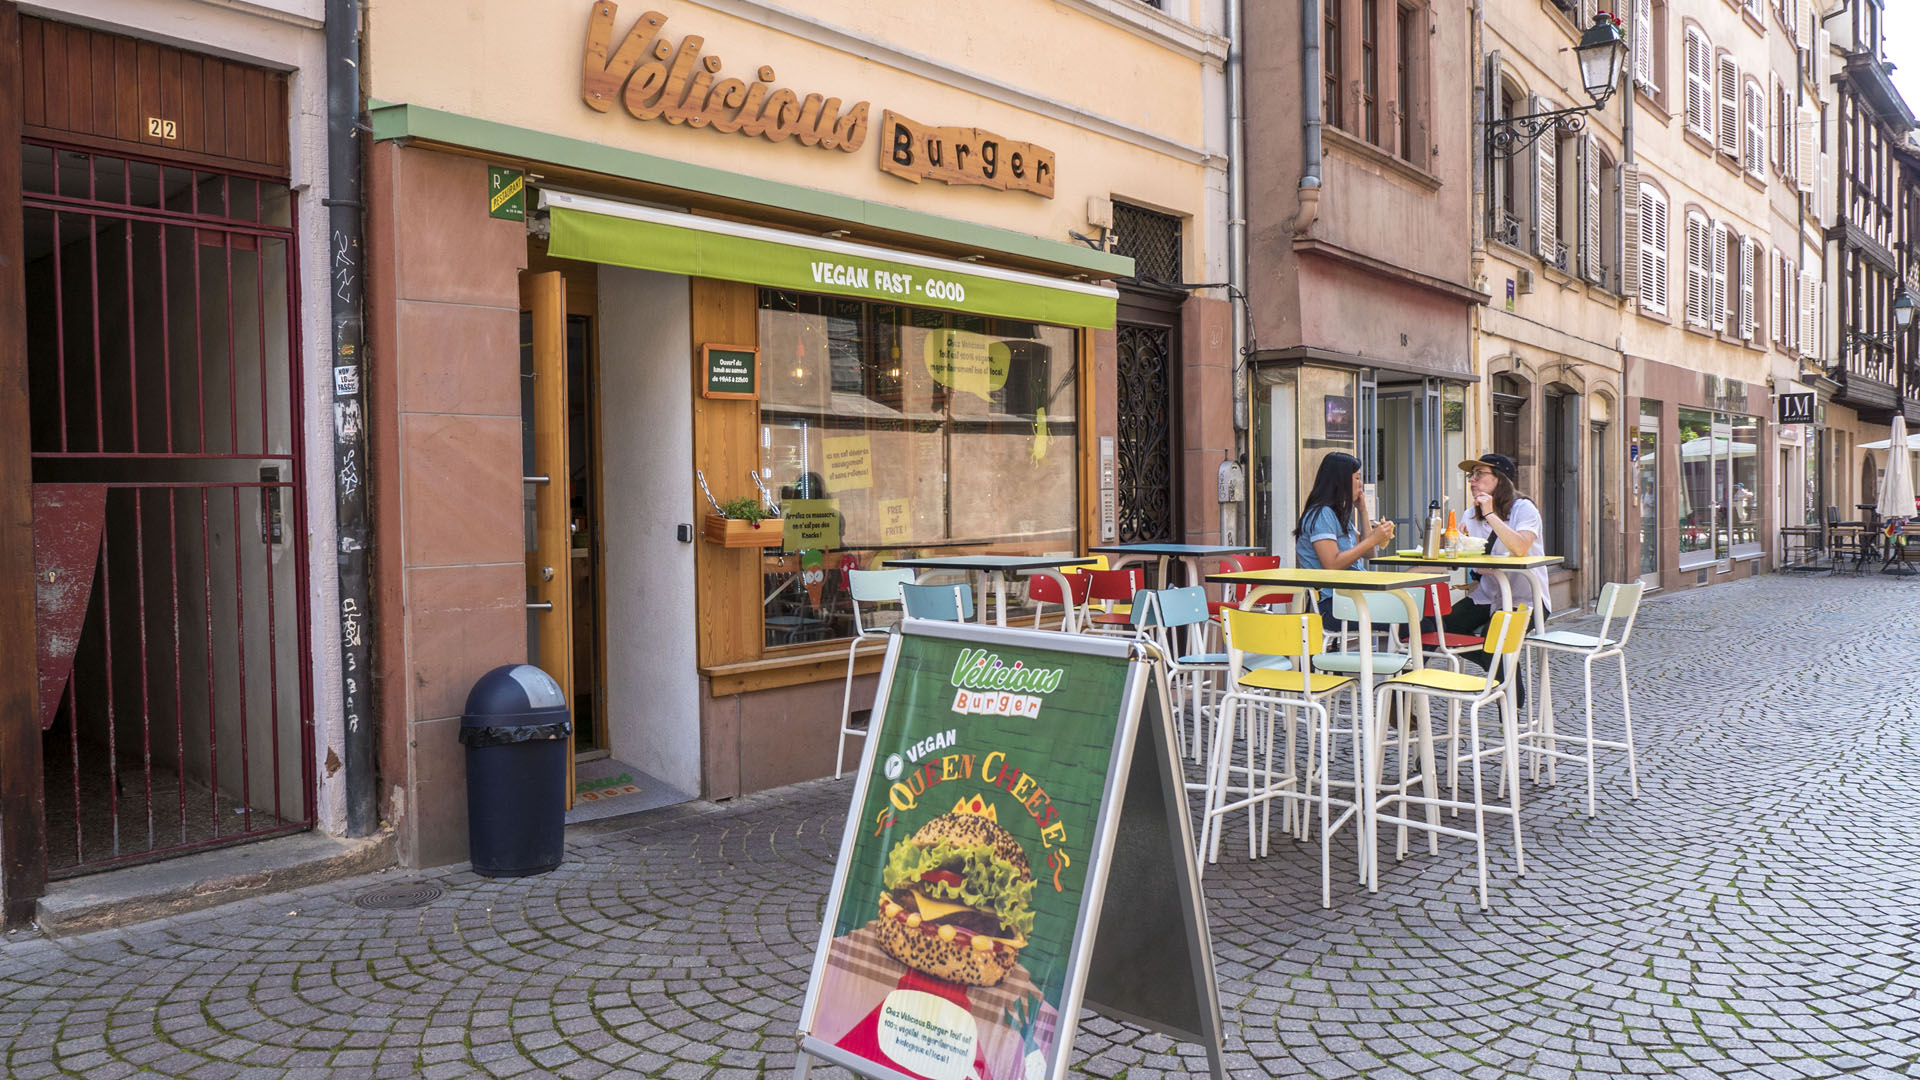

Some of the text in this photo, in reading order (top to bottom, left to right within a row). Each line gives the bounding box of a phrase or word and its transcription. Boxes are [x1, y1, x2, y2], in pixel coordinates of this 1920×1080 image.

[150, 120, 174, 138] 22
[893, 122, 1050, 184] Burger
[493, 177, 522, 208] RESTAURANT
[494, 174, 500, 189] R
[811, 262, 869, 288] VEGAN
[874, 270, 912, 294] FAST
[925, 278, 965, 302] GOOD
[1400, 332, 1408, 347] 18
[1784, 396, 1810, 416] LM
[888, 505, 903, 515] FREE
[886, 525, 903, 536] FRITE
[951, 648, 1064, 693] Vélicious
[956, 692, 1038, 712] Burger
[906, 729, 956, 763] VEGAN
[889, 751, 1066, 848] QUEEN CHEESE
[886, 1006, 900, 1017] Chez
[926, 1021, 948, 1036] Burger
